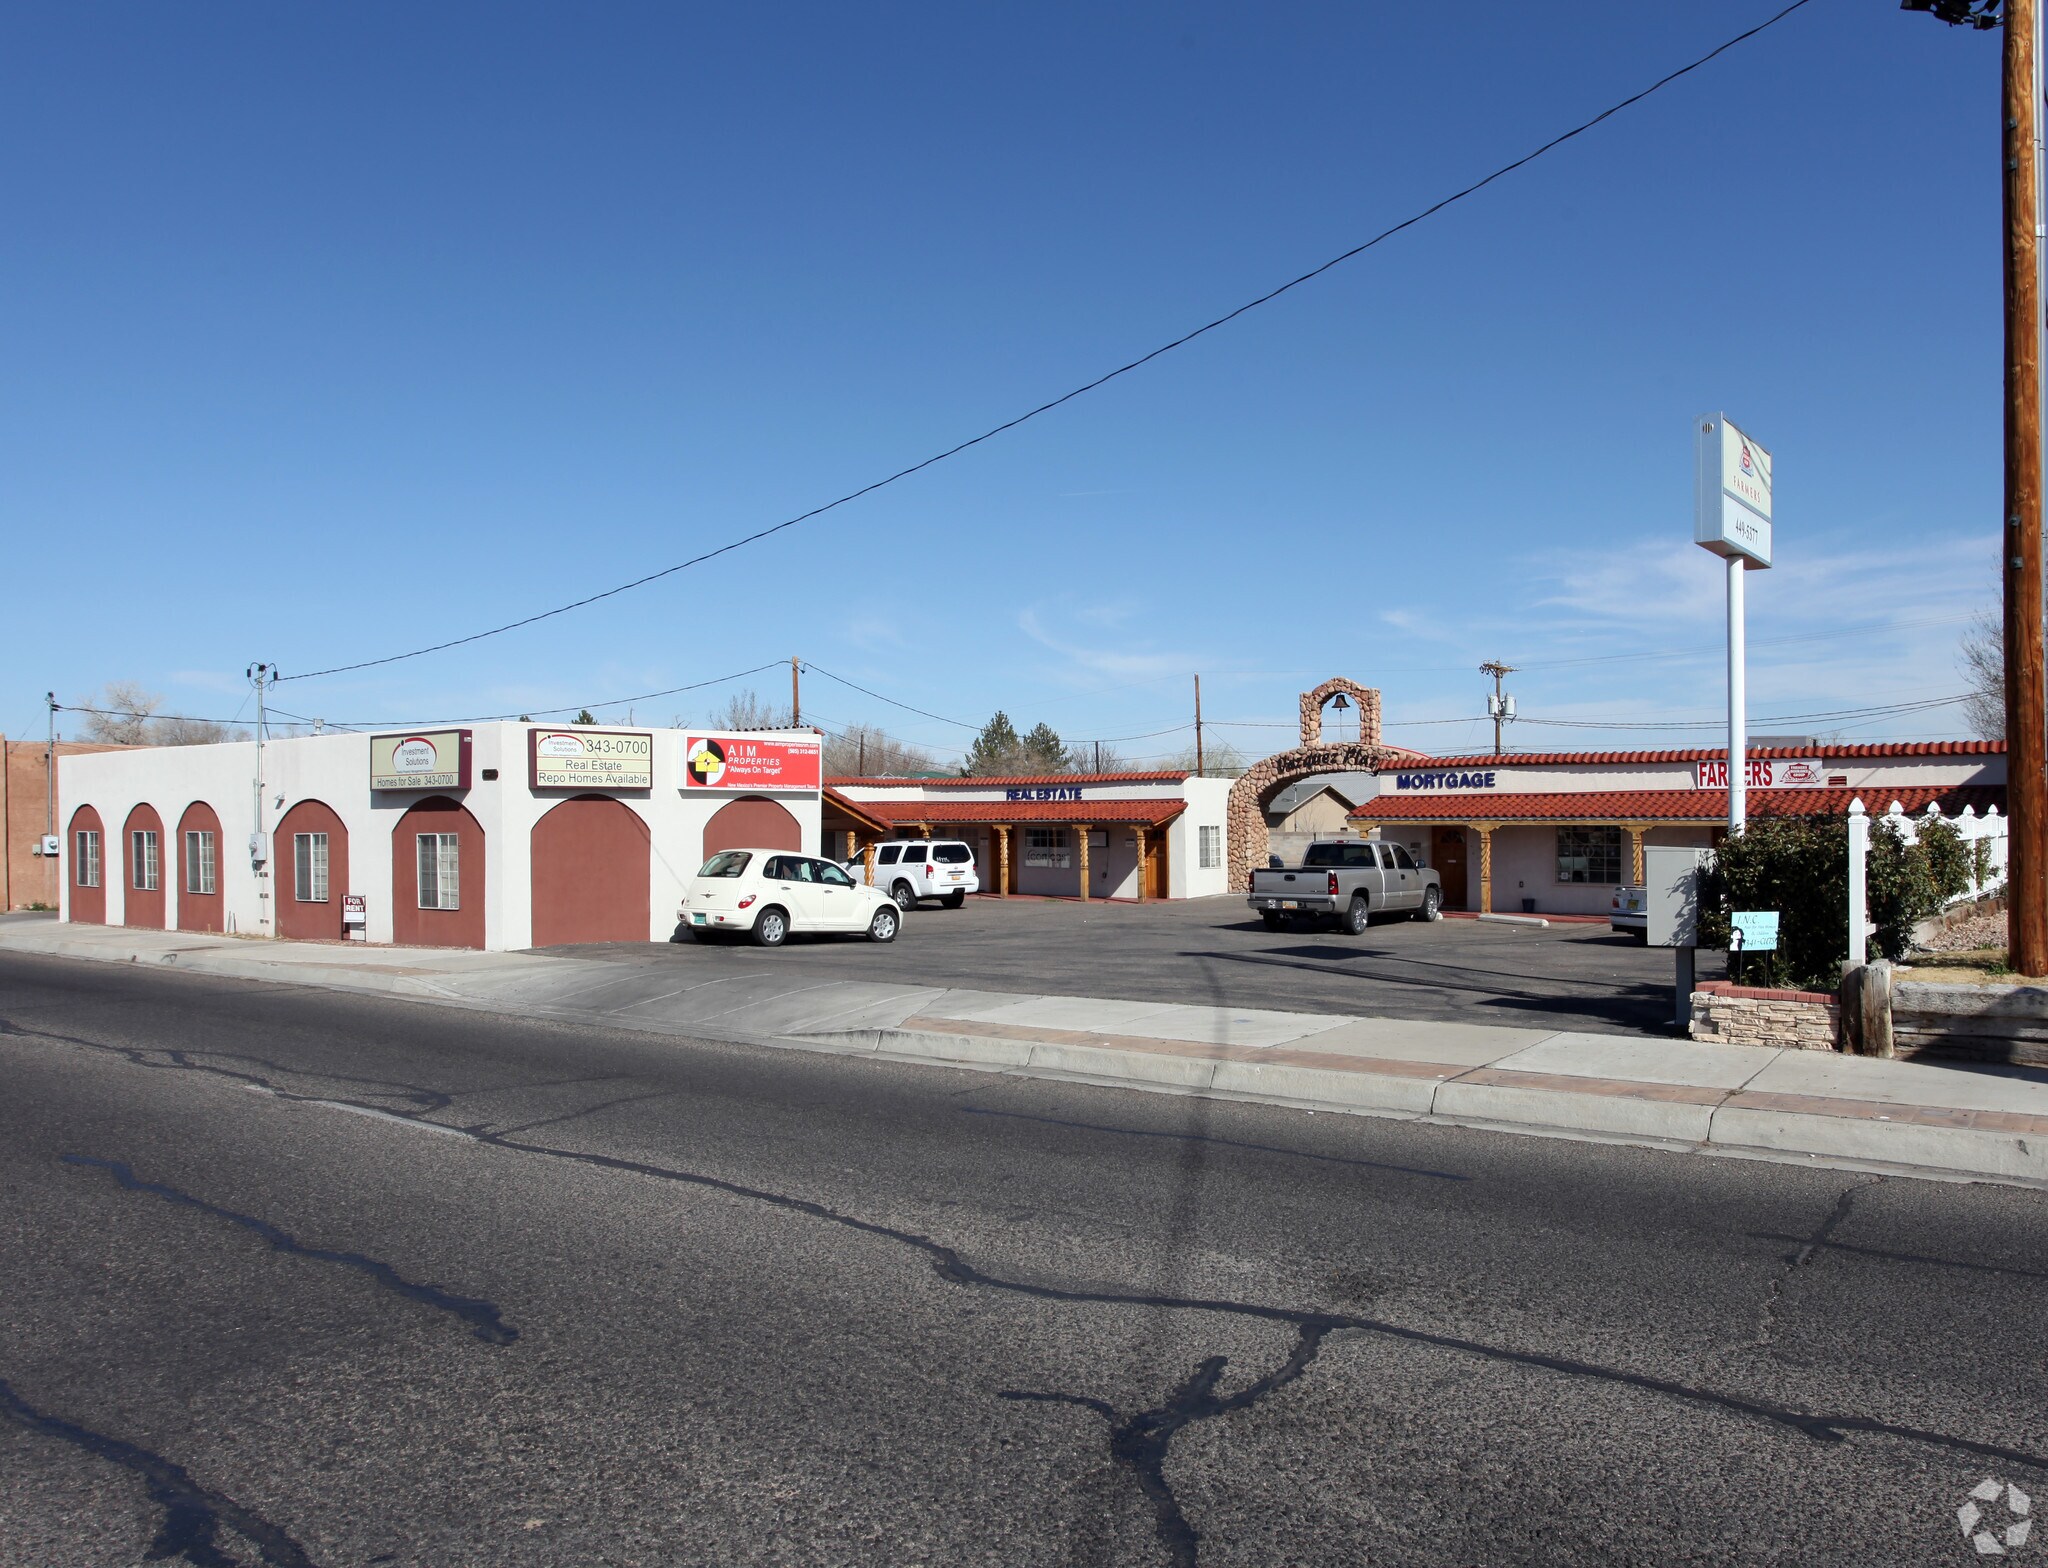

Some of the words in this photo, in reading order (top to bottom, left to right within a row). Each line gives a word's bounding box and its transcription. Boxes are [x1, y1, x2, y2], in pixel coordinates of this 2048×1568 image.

[1733, 475, 1761, 503] FARMERS
[401, 747, 429, 757] Investment
[586, 739, 648, 754] 343-0700
[405, 757, 429, 767] Solutions
[565, 760, 589, 770] Real
[591, 760, 622, 771] Estate
[728, 757, 780, 766] PROPERTIES
[1343, 747, 1379, 773] Plaz
[752, 766, 762, 774] On
[1699, 760, 1773, 787] FARERS
[377, 777, 397, 787] Homes
[398, 776, 406, 786] for
[407, 776, 421, 786] Sale
[424, 774, 454, 786] 343-0700
[538, 772, 566, 784] Repo
[568, 773, 603, 783] Homes
[605, 774, 648, 784] Available
[1396, 772, 1496, 790] MORTGAGE
[1006, 788, 1035, 800] REAL
[1035, 787, 1083, 801] ESTATE
[347, 897, 361, 905] FOR
[346, 904, 365, 912] RENT
